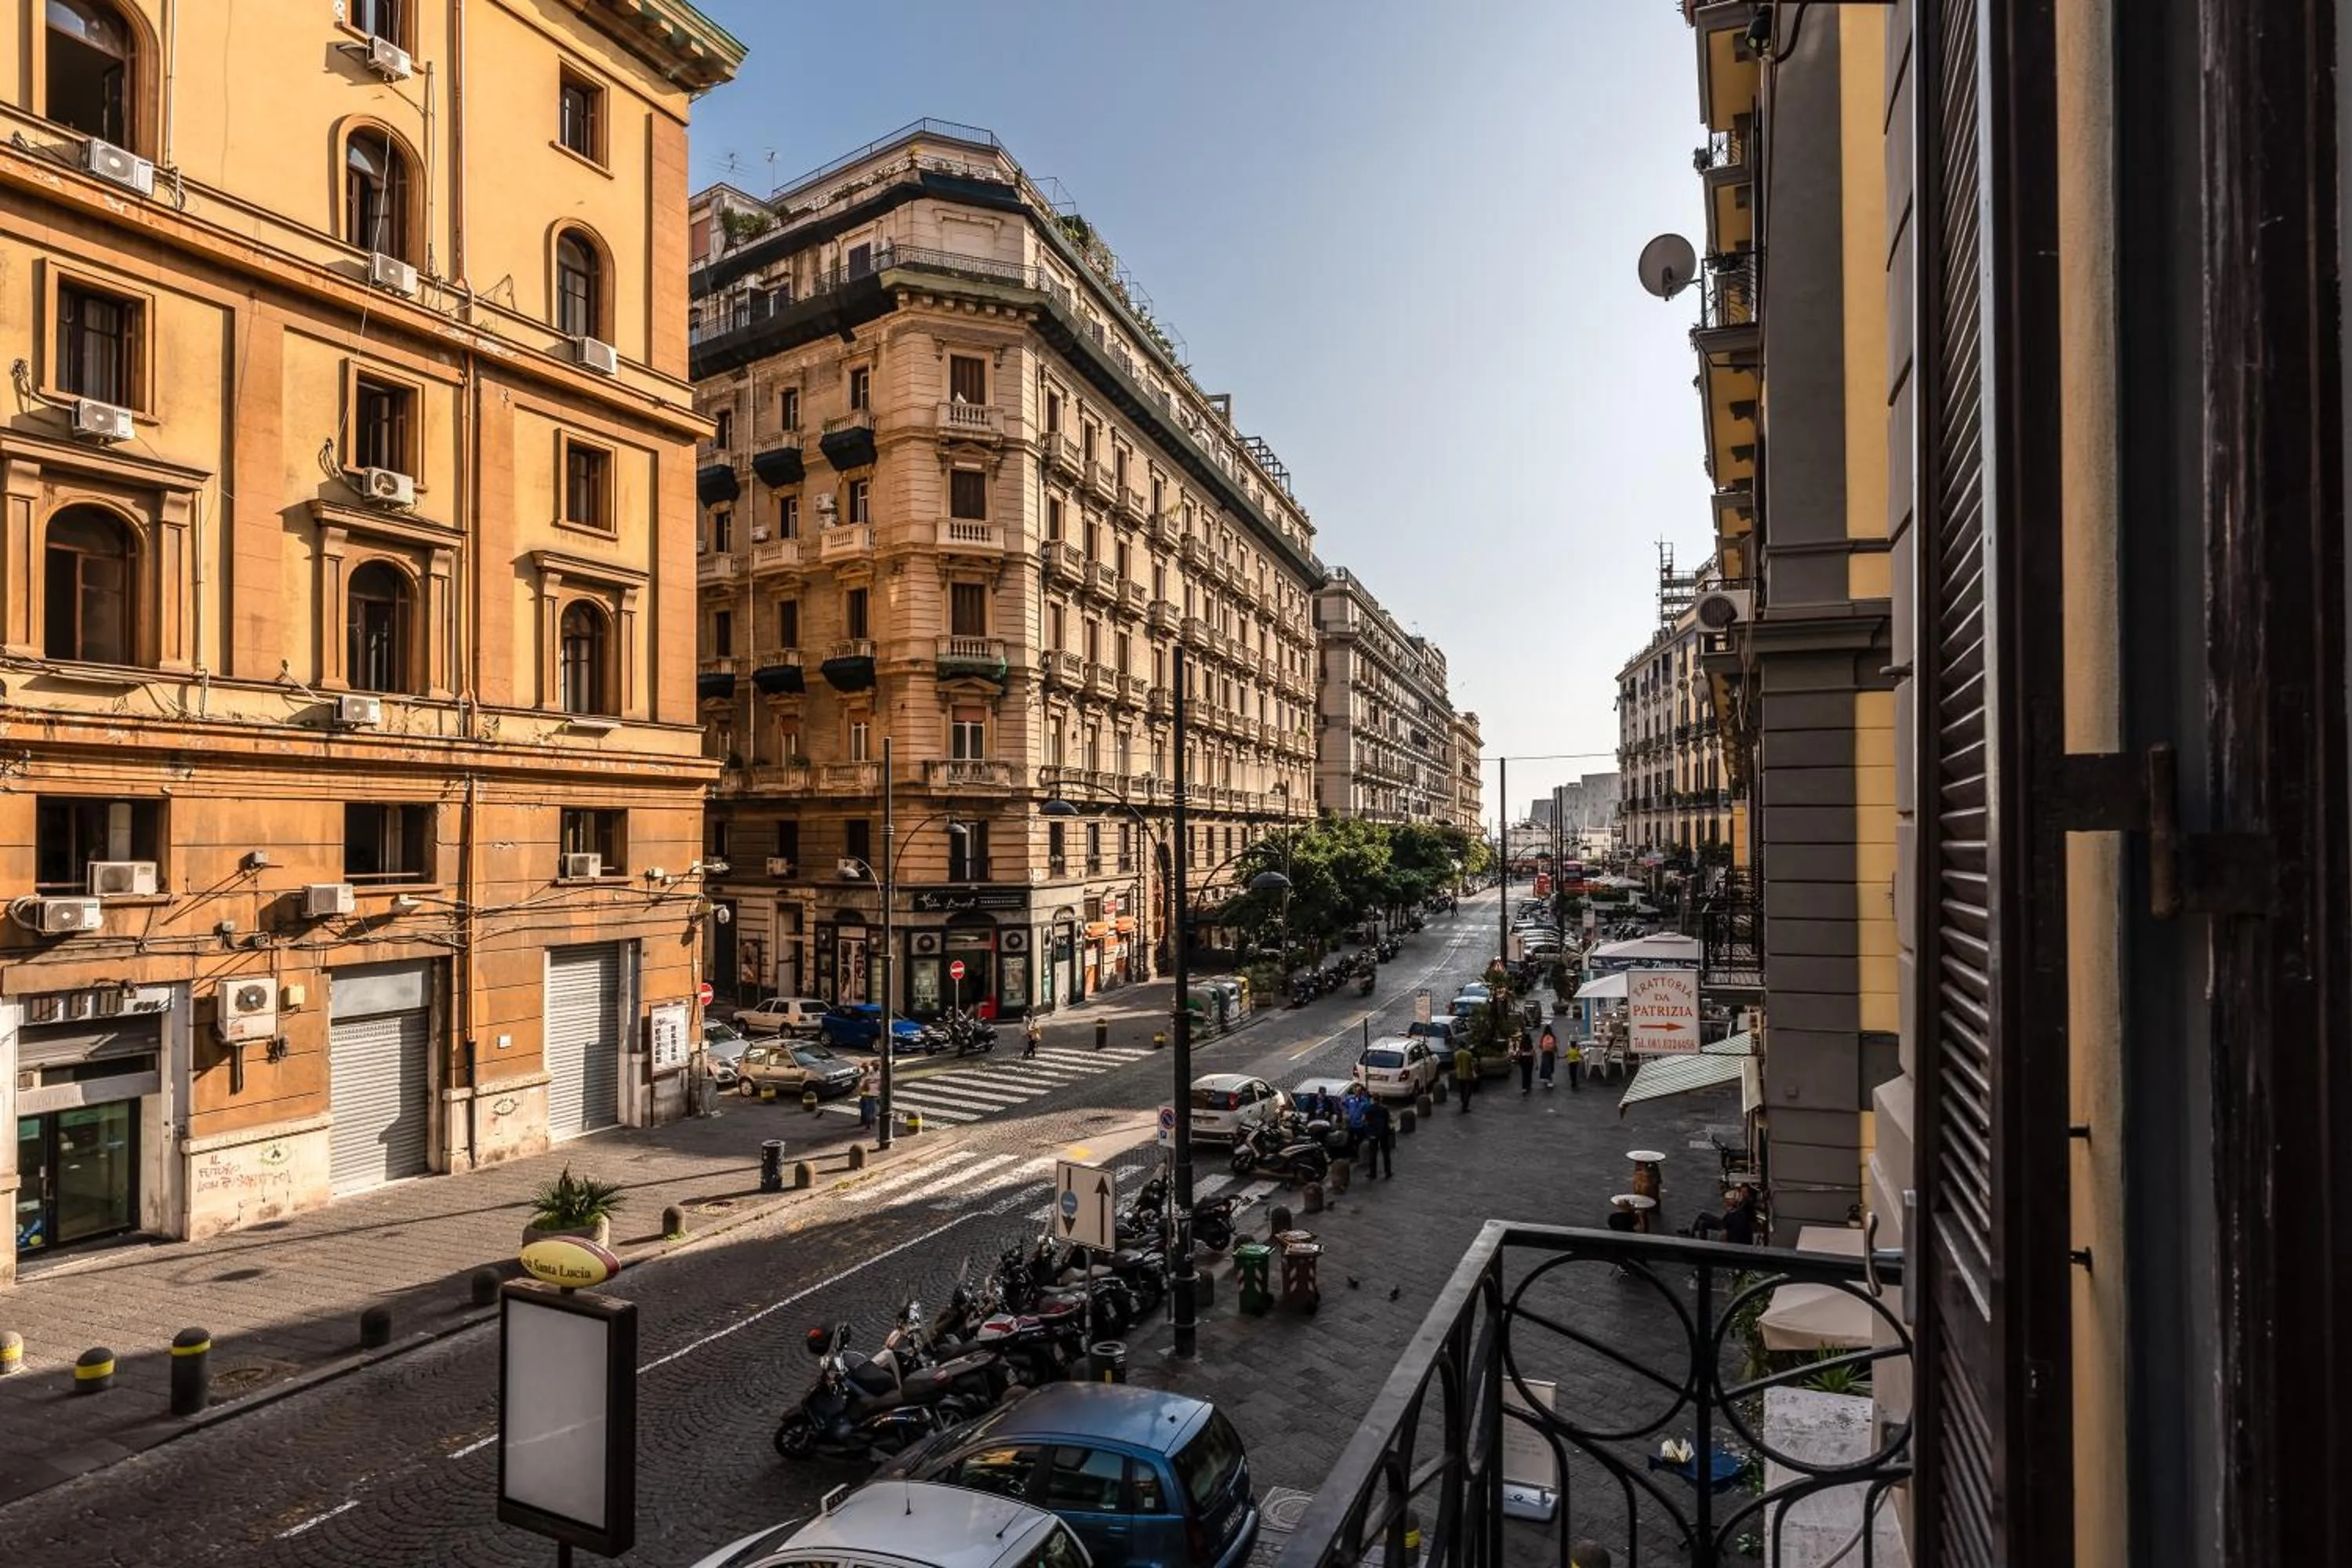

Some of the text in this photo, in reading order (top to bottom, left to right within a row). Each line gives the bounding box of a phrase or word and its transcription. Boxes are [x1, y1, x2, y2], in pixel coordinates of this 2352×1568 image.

[1632, 977, 1693, 999] TRATTORIA
[1655, 993, 1670, 1002] DA
[1633, 1005, 1693, 1017] PATRIZIA
[559, 1264, 591, 1279] Lucia
